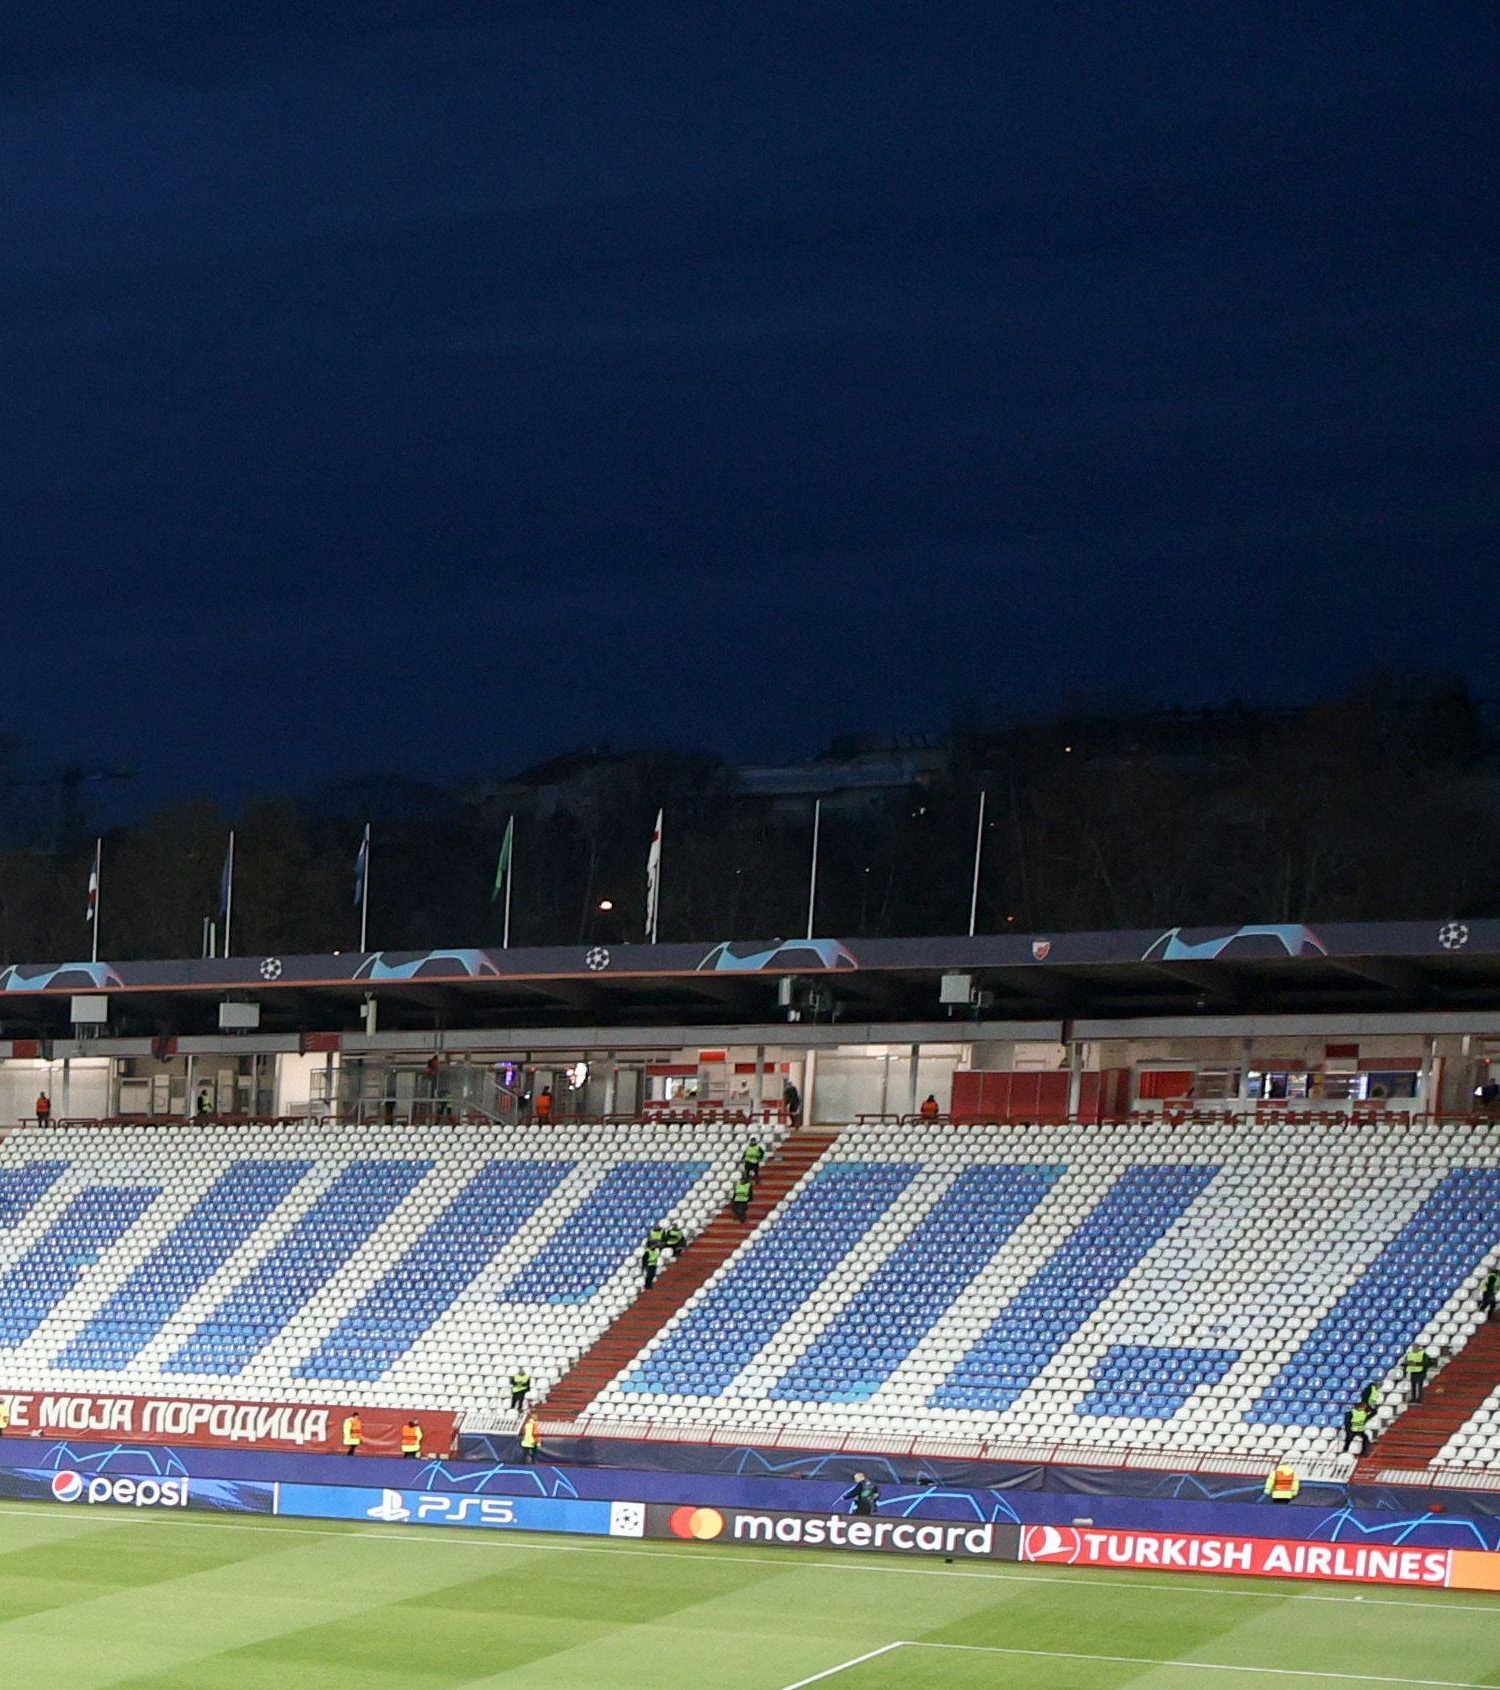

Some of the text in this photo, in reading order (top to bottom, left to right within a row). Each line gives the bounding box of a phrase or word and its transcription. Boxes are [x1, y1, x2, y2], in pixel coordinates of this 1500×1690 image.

[38, 1397, 133, 1433] МОЈА
[140, 1402, 329, 1445] ПОРОДИЦА
[87, 1475, 191, 1507] pepsi
[417, 1497, 514, 1523] PS5
[734, 1511, 993, 1554] mastercard
[1084, 1533, 1447, 1582] TURKISH AIRLINES
